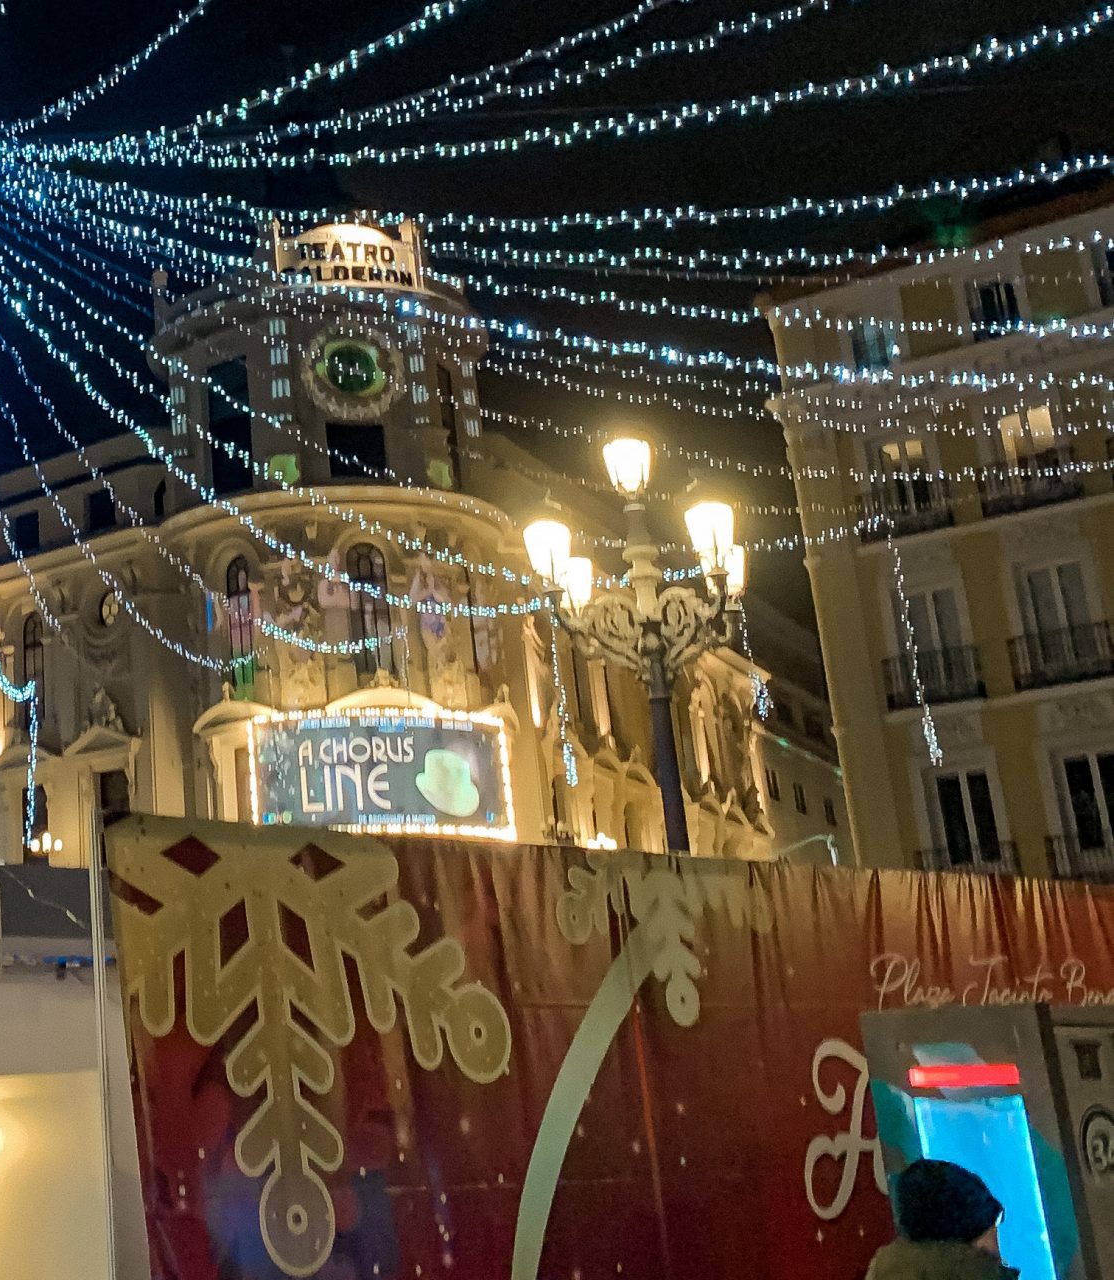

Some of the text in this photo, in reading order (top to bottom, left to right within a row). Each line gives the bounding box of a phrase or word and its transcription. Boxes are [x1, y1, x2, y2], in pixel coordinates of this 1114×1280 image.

[298, 240, 396, 264] TEATRO
[298, 736, 415, 767] A CHORUS
[299, 763, 392, 813] LINE
